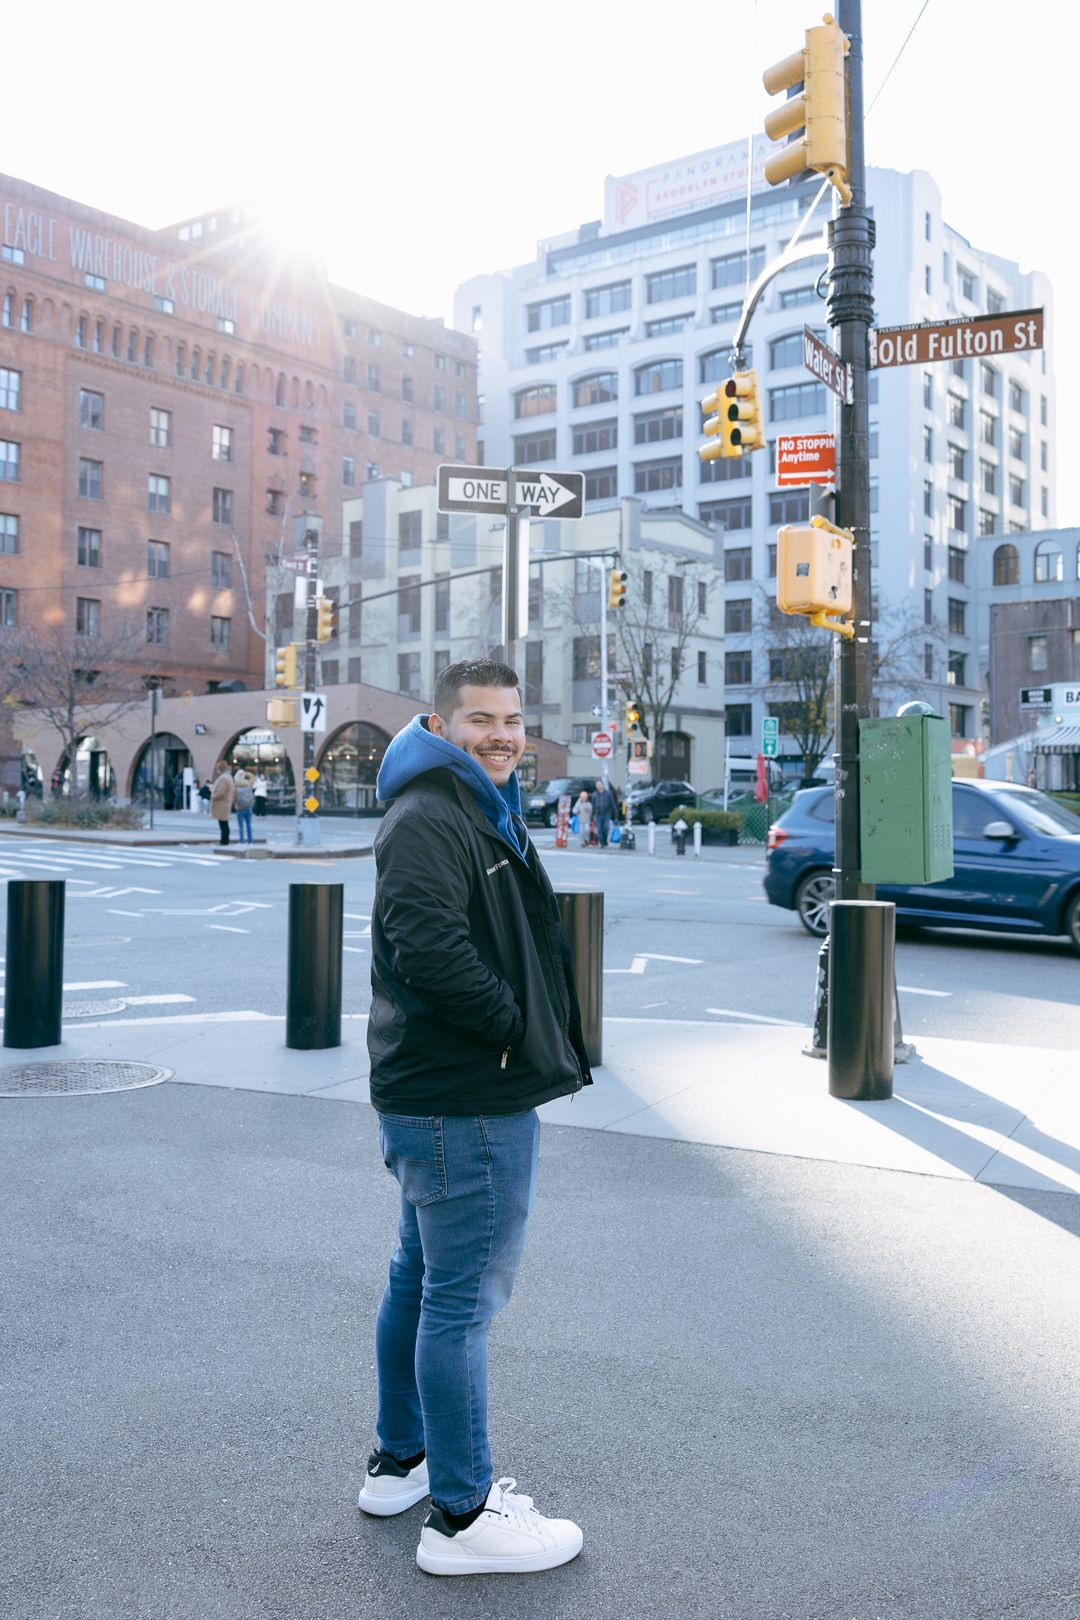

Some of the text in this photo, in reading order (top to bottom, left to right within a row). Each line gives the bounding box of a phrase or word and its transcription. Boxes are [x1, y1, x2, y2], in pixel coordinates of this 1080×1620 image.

[69, 225, 161, 294] WAREHOUSE
[165, 262, 177, 301] &
[879, 320, 1037, 364] Old Fulton St
[804, 336, 833, 385] Water
[835, 366, 845, 397] St
[781, 438, 836, 451] NO STOPPIN
[781, 451, 820, 464] Anytime
[463, 481, 561, 503] ONE WAY
